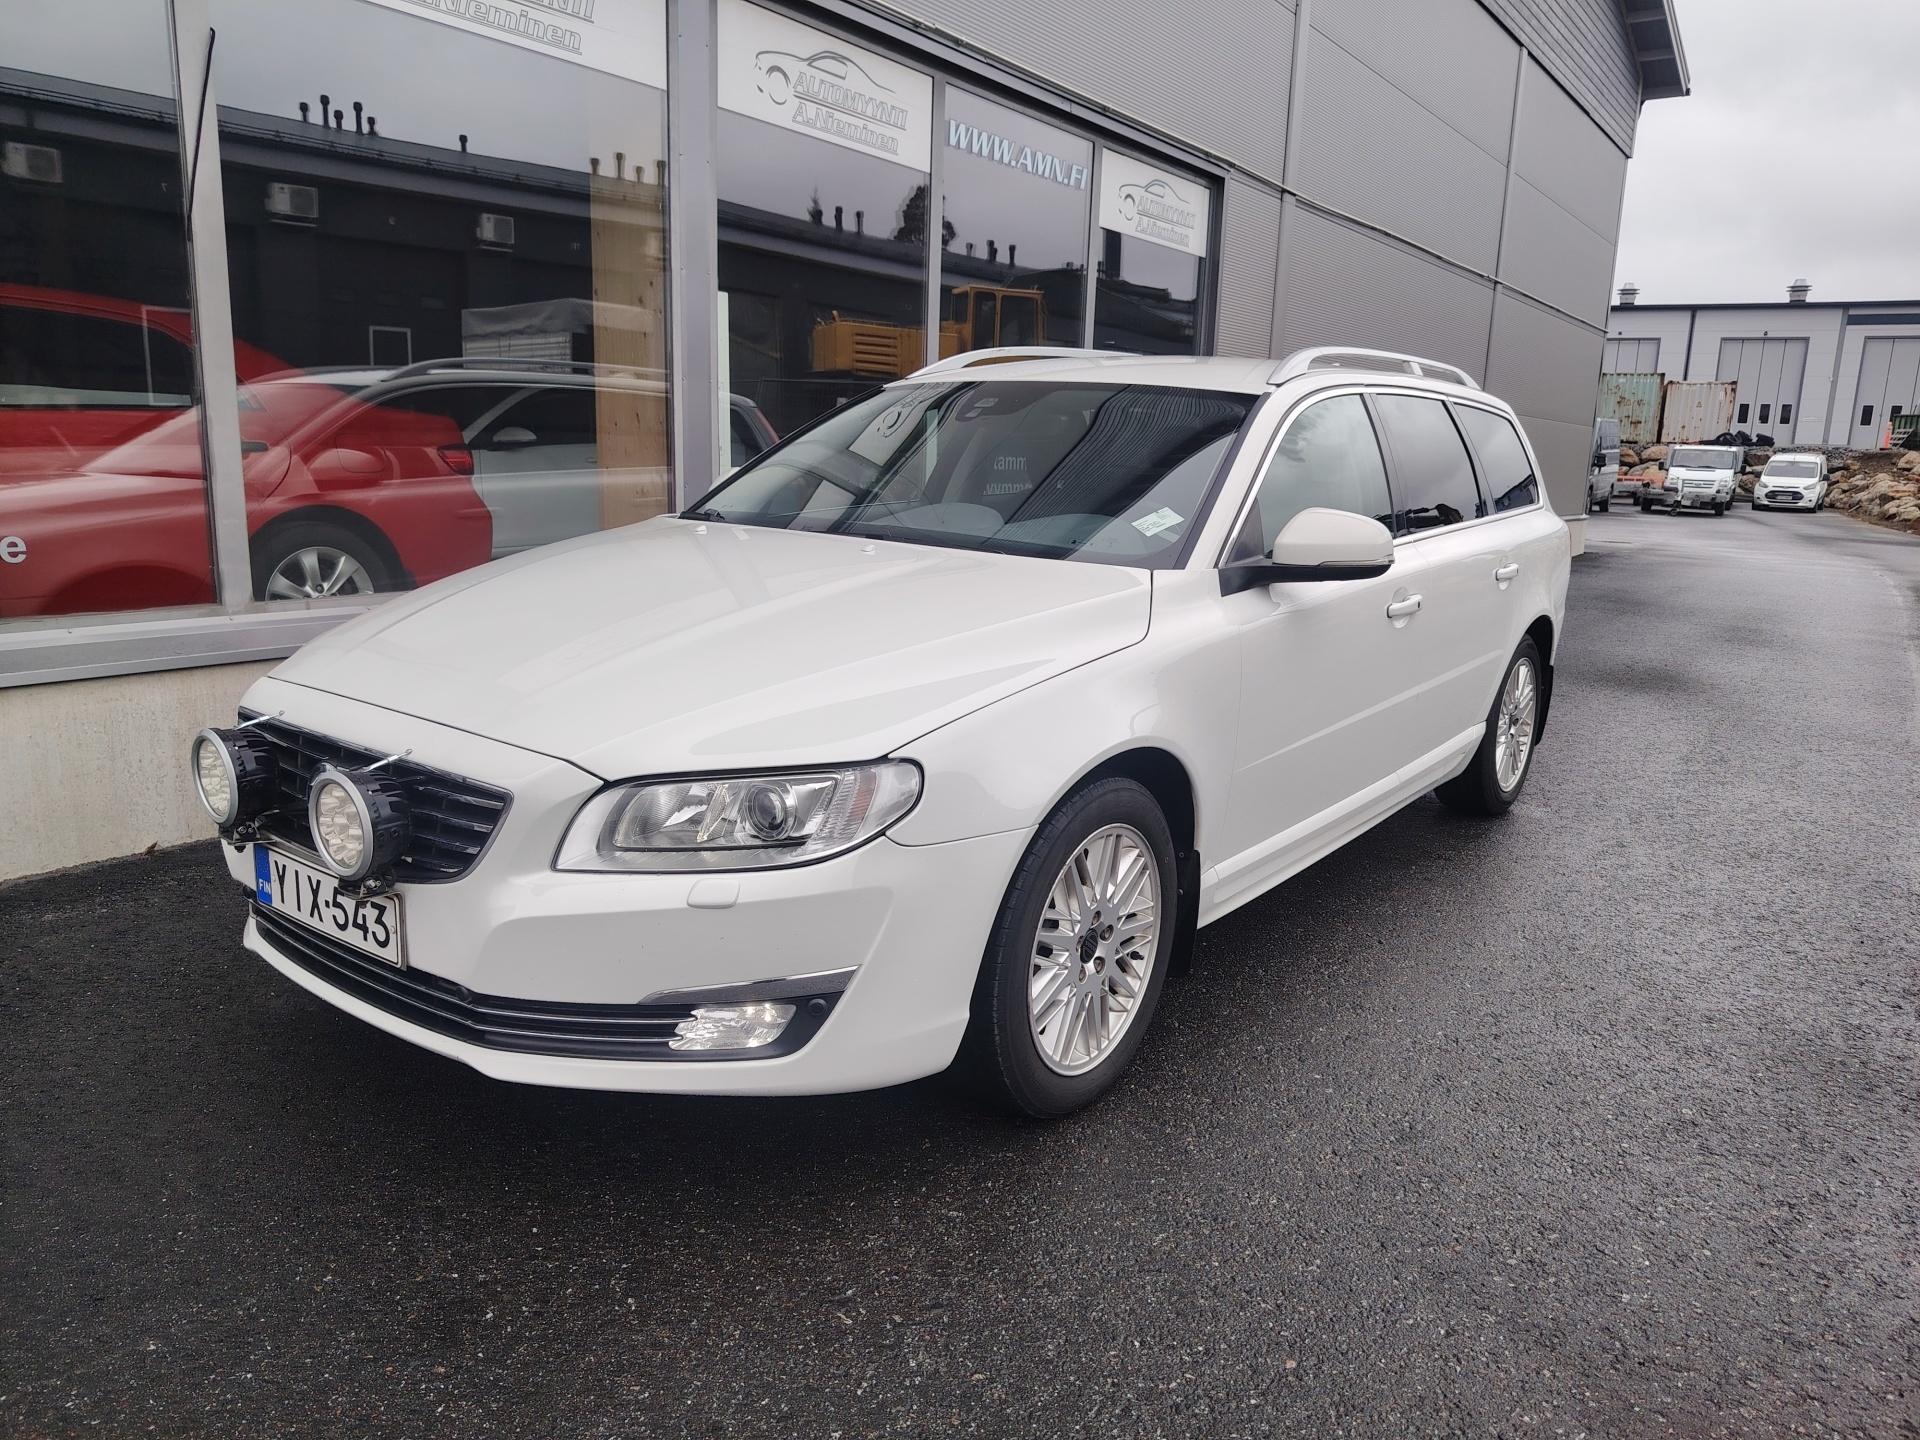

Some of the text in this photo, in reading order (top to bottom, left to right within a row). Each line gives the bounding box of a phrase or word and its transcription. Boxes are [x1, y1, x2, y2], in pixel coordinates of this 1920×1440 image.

[792, 101, 899, 153] A.Nieminen
[793, 71, 909, 129] AUTOMYYNTI
[949, 119, 1088, 190] WWW.AMN.FI
[259, 878, 272, 895] FIN
[274, 859, 391, 949] YIX-543
